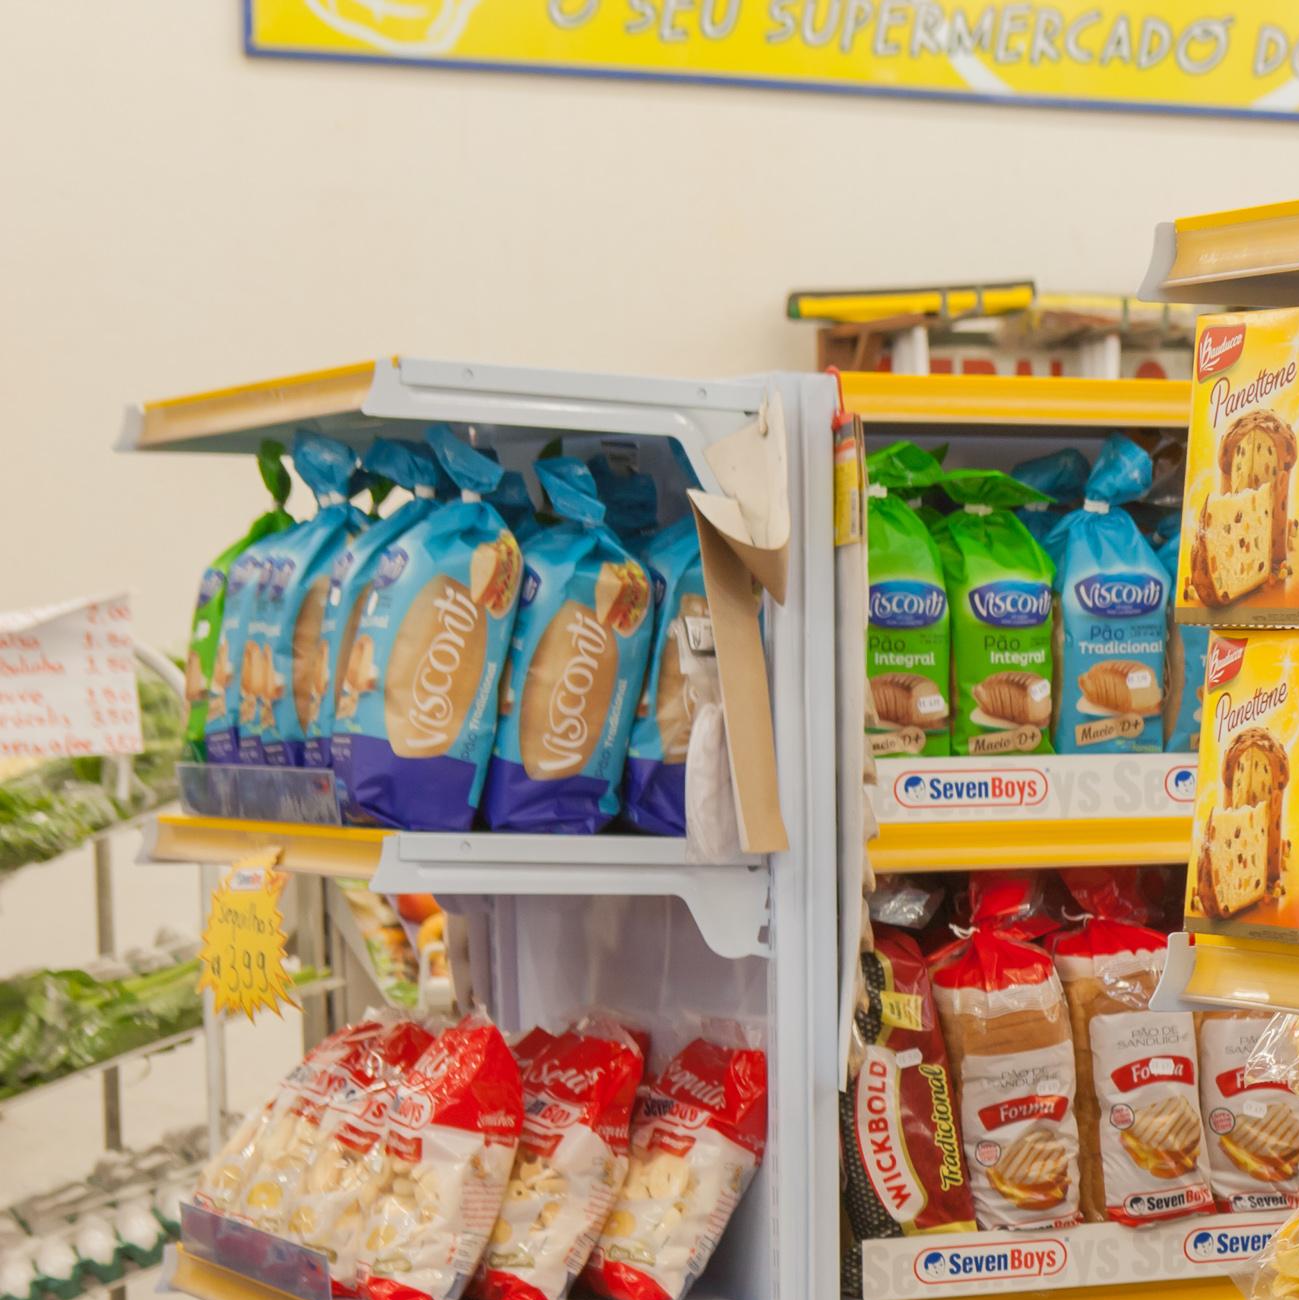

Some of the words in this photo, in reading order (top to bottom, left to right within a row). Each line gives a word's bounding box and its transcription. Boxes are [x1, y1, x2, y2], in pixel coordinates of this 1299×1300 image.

[624, 0, 742, 42] SEU
[765, 0, 1234, 76] SUPERMERCADO
[1202, 333, 1243, 370] Bauducco
[1210, 360, 1297, 428] Panettone
[974, 590, 1052, 619] Visconti
[1079, 581, 1161, 610] Visconti
[869, 636, 906, 652] Pão
[984, 635, 1021, 651] Pão
[1078, 640, 1163, 655] Tradicional
[1090, 624, 1125, 641] Pão
[406, 586, 478, 748] Visconti
[874, 651, 936, 668] Integral
[990, 649, 1046, 667] Integral
[1210, 646, 1243, 684] Bauducco
[538, 610, 607, 770] Visconti
[1215, 681, 1288, 742] Panettone
[1000, 1099, 1056, 1123] Forma
[866, 1060, 913, 1211] WICKBOLD
[920, 1064, 963, 1192] Tradicional
